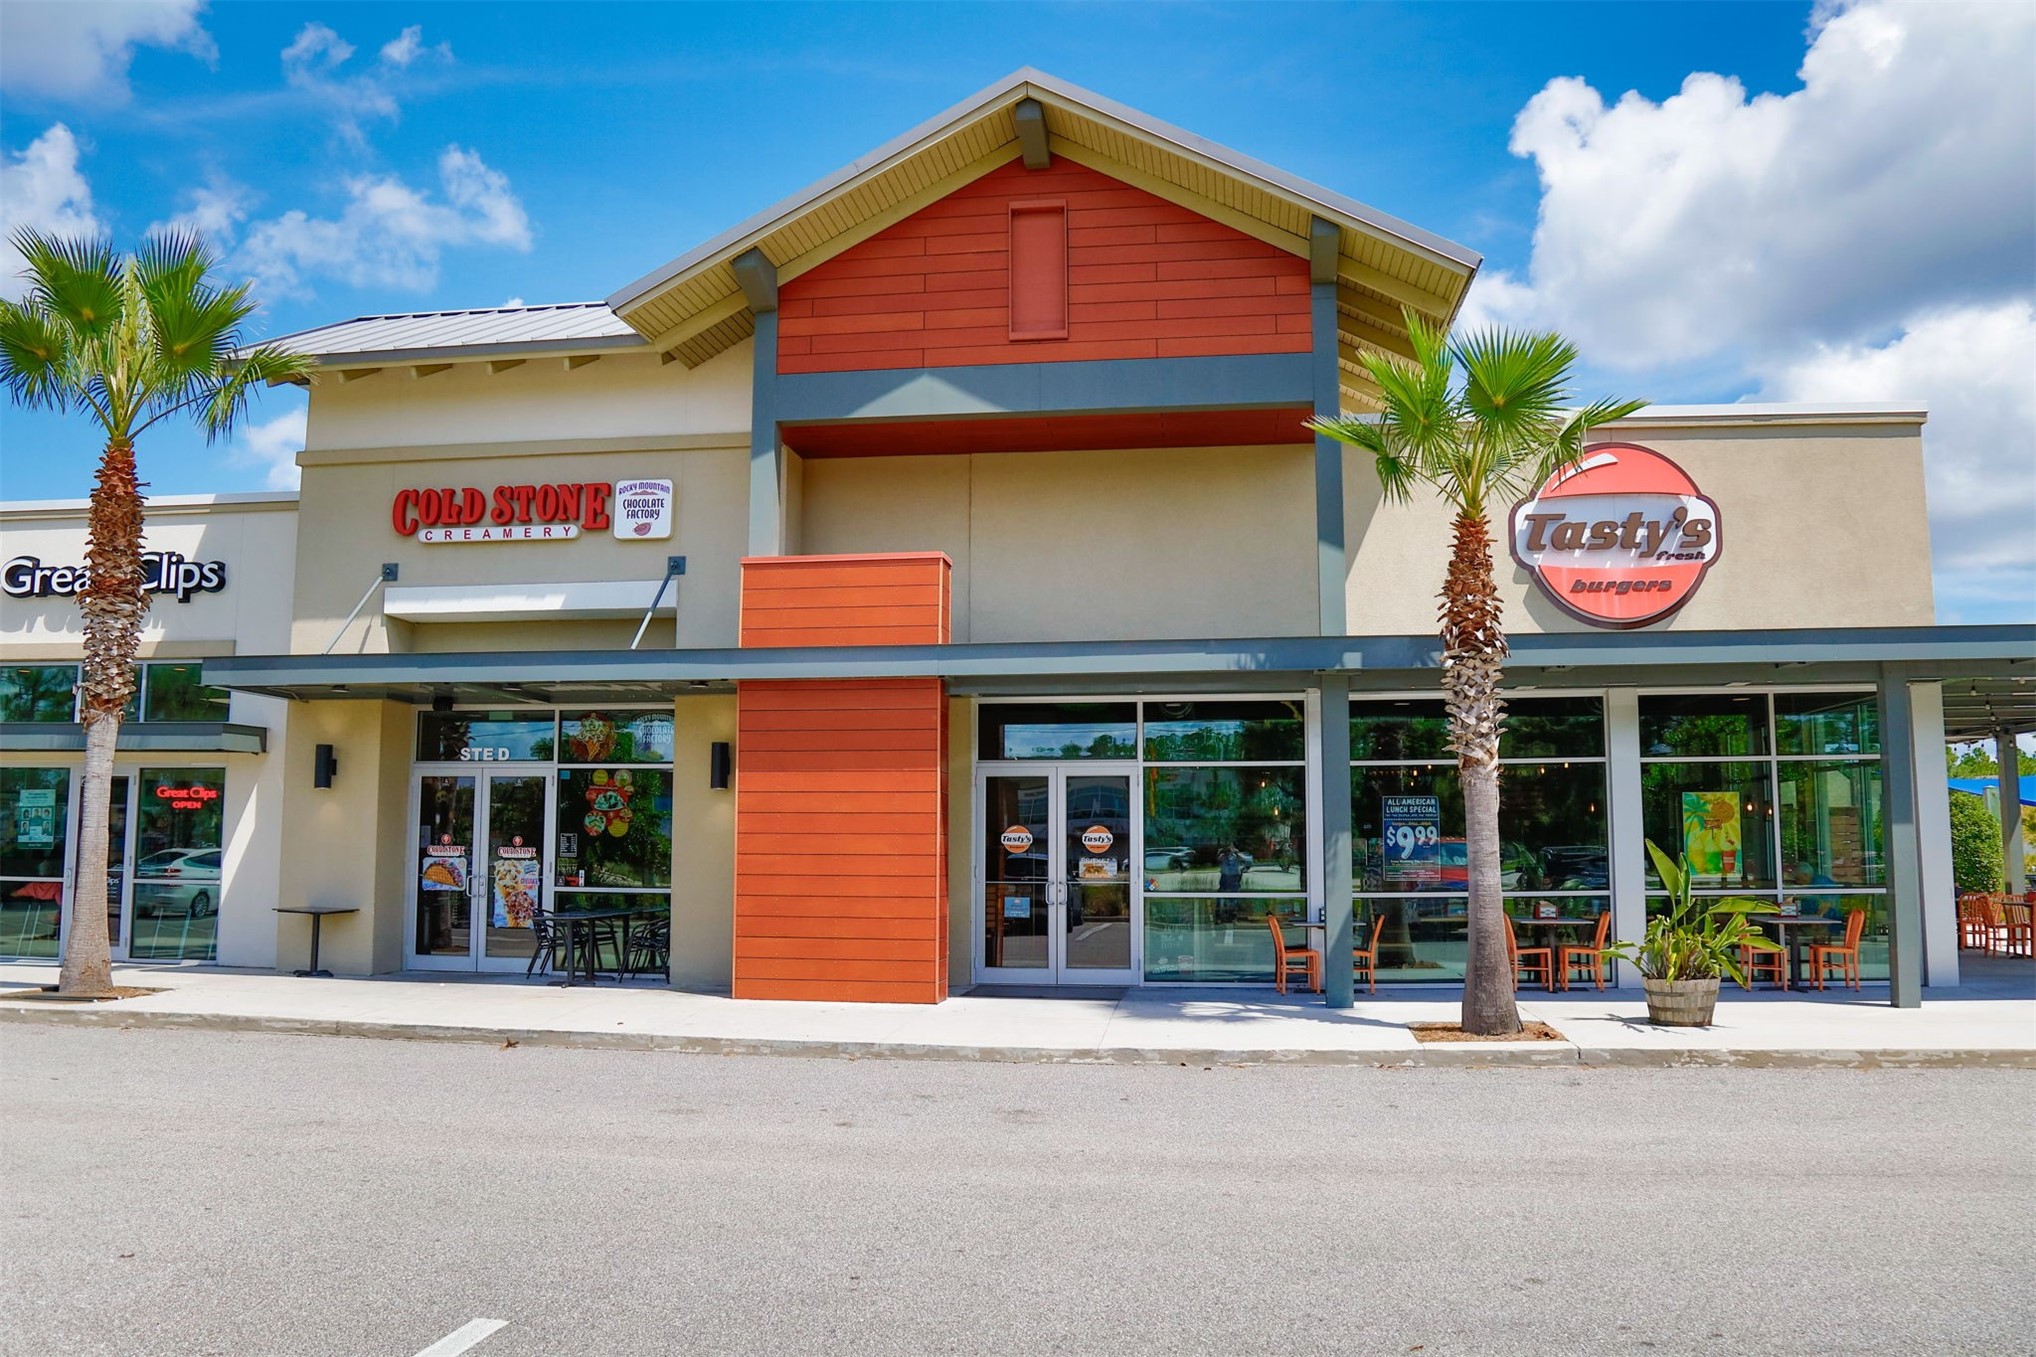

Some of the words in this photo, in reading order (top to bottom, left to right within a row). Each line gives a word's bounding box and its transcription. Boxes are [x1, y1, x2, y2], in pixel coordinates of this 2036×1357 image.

[619, 483, 637, 495] ROCKY
[639, 482, 671, 494] MOUNTAIN
[393, 488, 486, 536] COLD
[491, 482, 611, 530] STONE
[623, 499, 665, 510] CHOCOLATE
[627, 509, 660, 520] FACTORY
[425, 526, 573, 541] CREAMERY
[1524, 506, 1712, 559] Tasty's
[1656, 551, 1706, 561] fresh
[0, 556, 91, 598] Grea
[1570, 579, 1672, 595] burgers
[460, 747, 494, 761] STE
[498, 747, 510, 761] D
[156, 786, 188, 798] Great
[190, 786, 217, 801] Clips
[172, 801, 201, 809] OPEN
[1003, 835, 1031, 843] Tasty's
[1084, 835, 1111, 843] Tasty's
